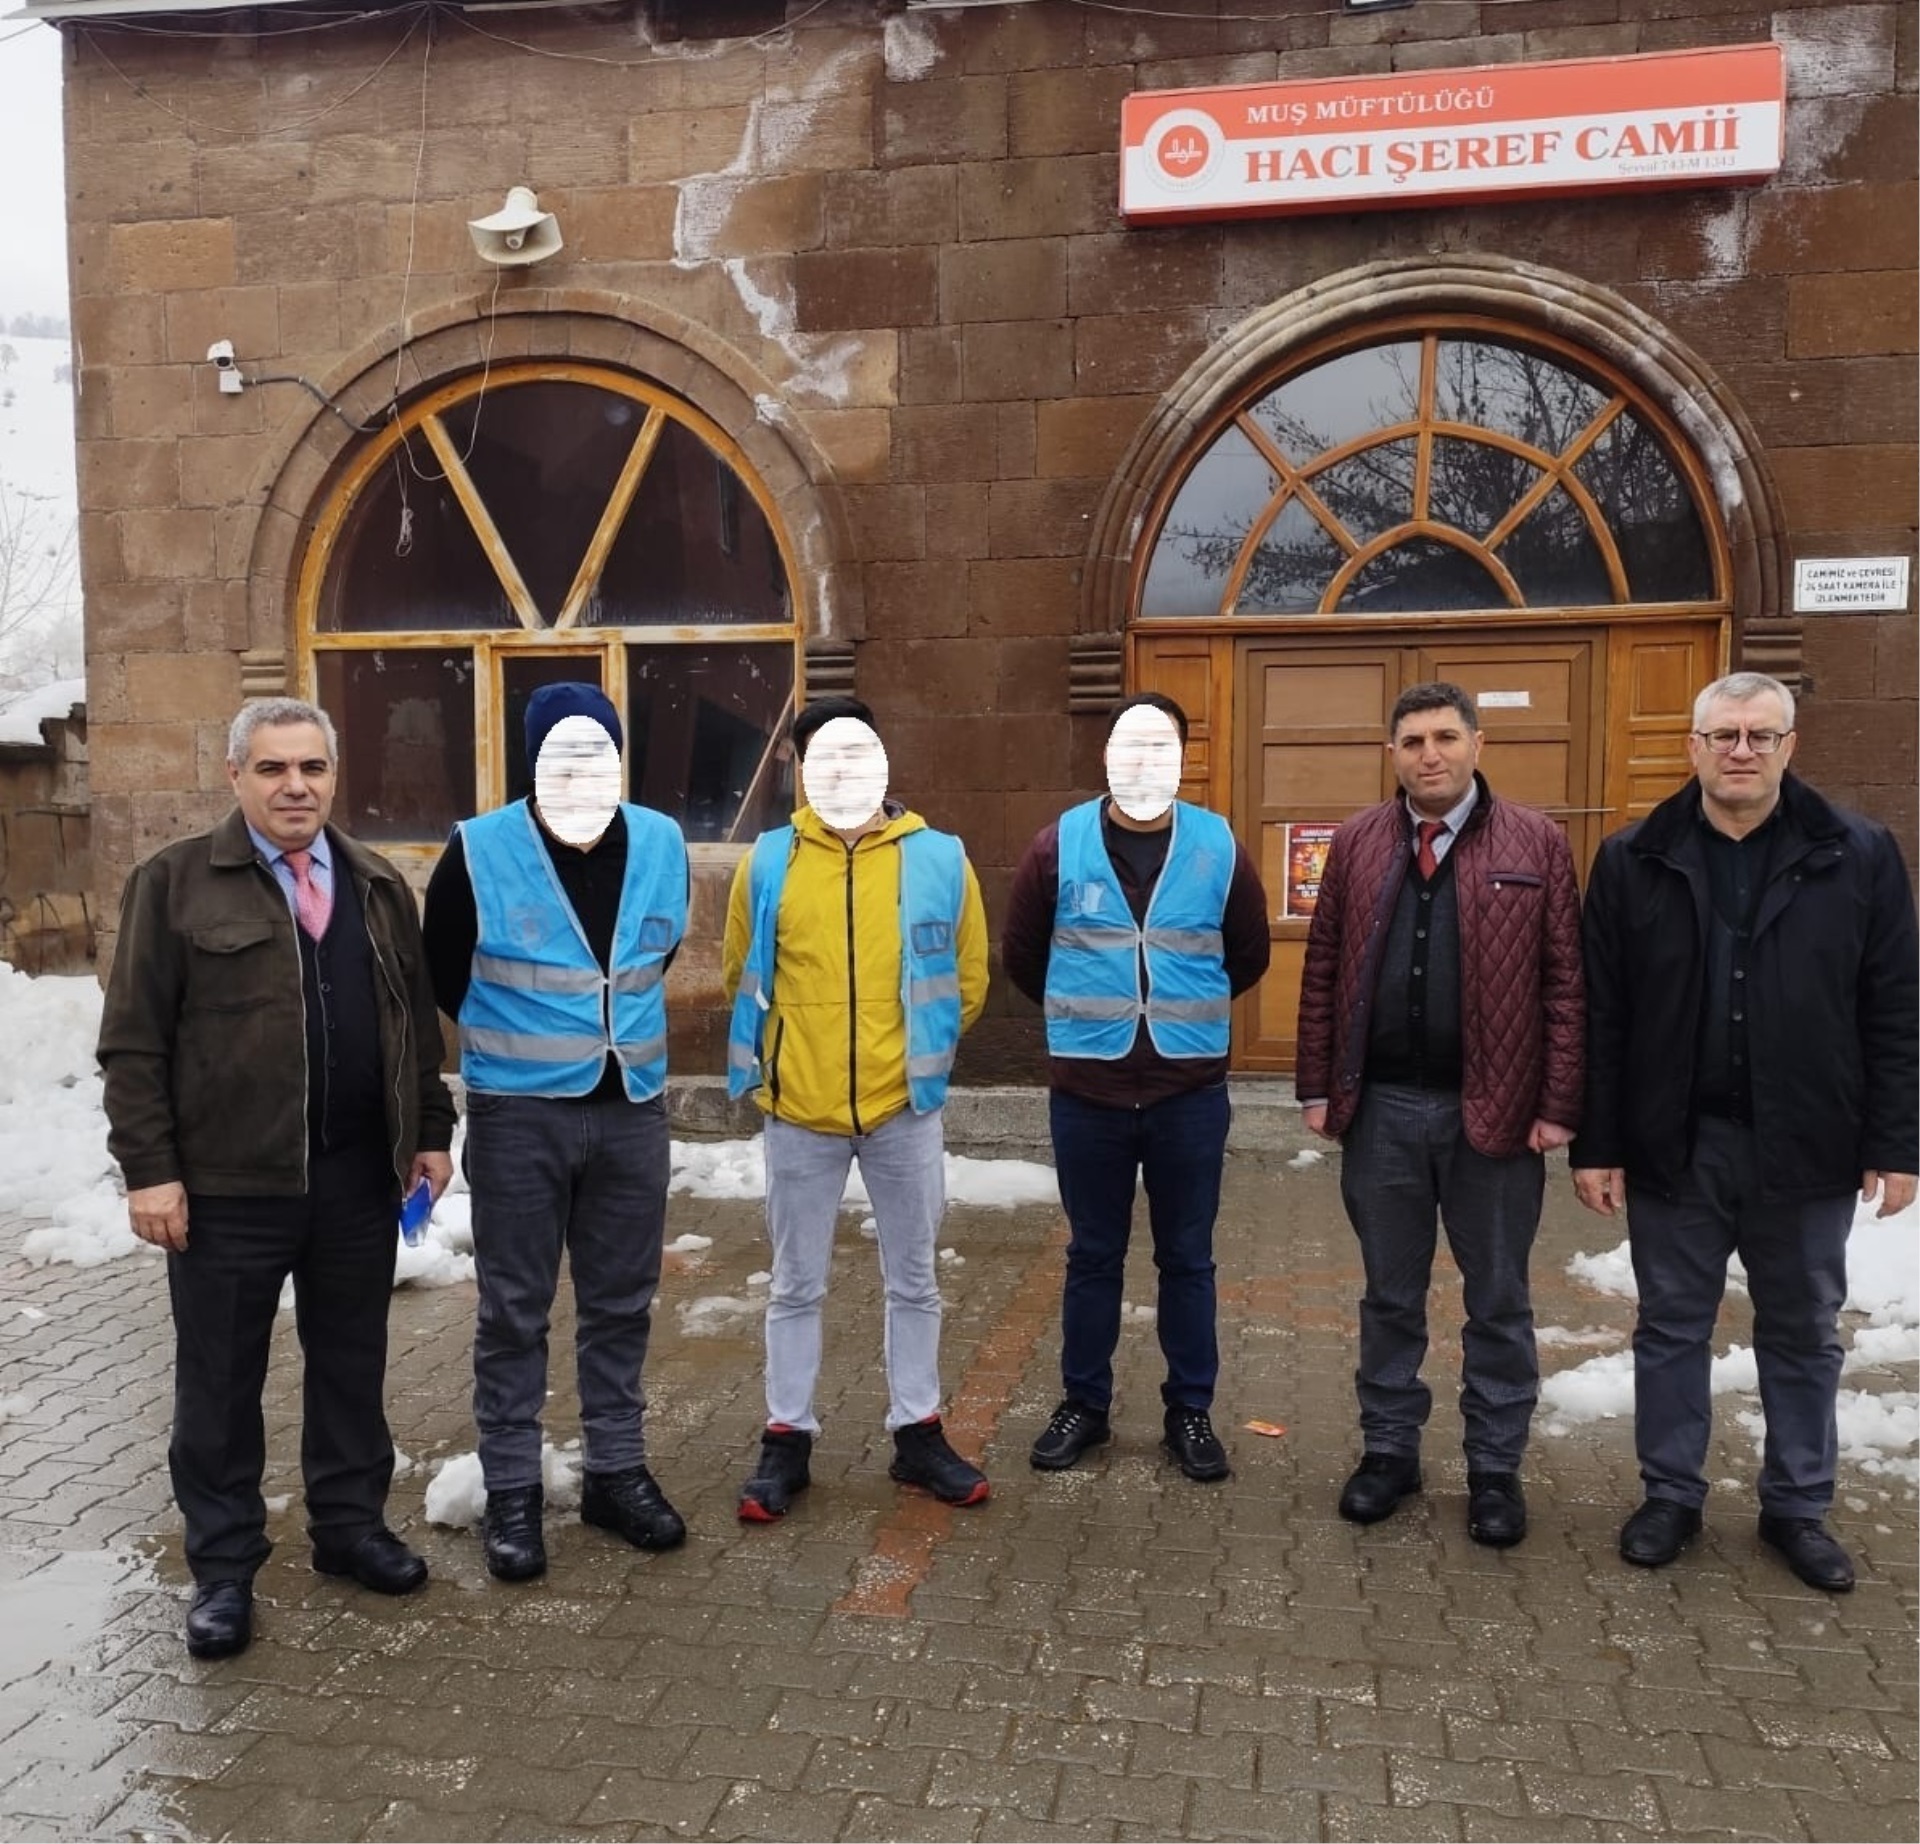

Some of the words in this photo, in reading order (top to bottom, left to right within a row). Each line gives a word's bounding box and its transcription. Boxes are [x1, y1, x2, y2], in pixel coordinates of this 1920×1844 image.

[1246, 102, 1308, 126] MUŞ
[1315, 86, 1495, 120] MÜFTÜLÜĞÜ
[1244, 143, 1374, 184] HACI
[1386, 129, 1563, 184] ŞEREF
[1575, 107, 1741, 161] CAMİİ
[1805, 582, 1816, 591] 24
[1817, 581, 1841, 591] SAAT
[1843, 580, 1880, 590] KAMERA
